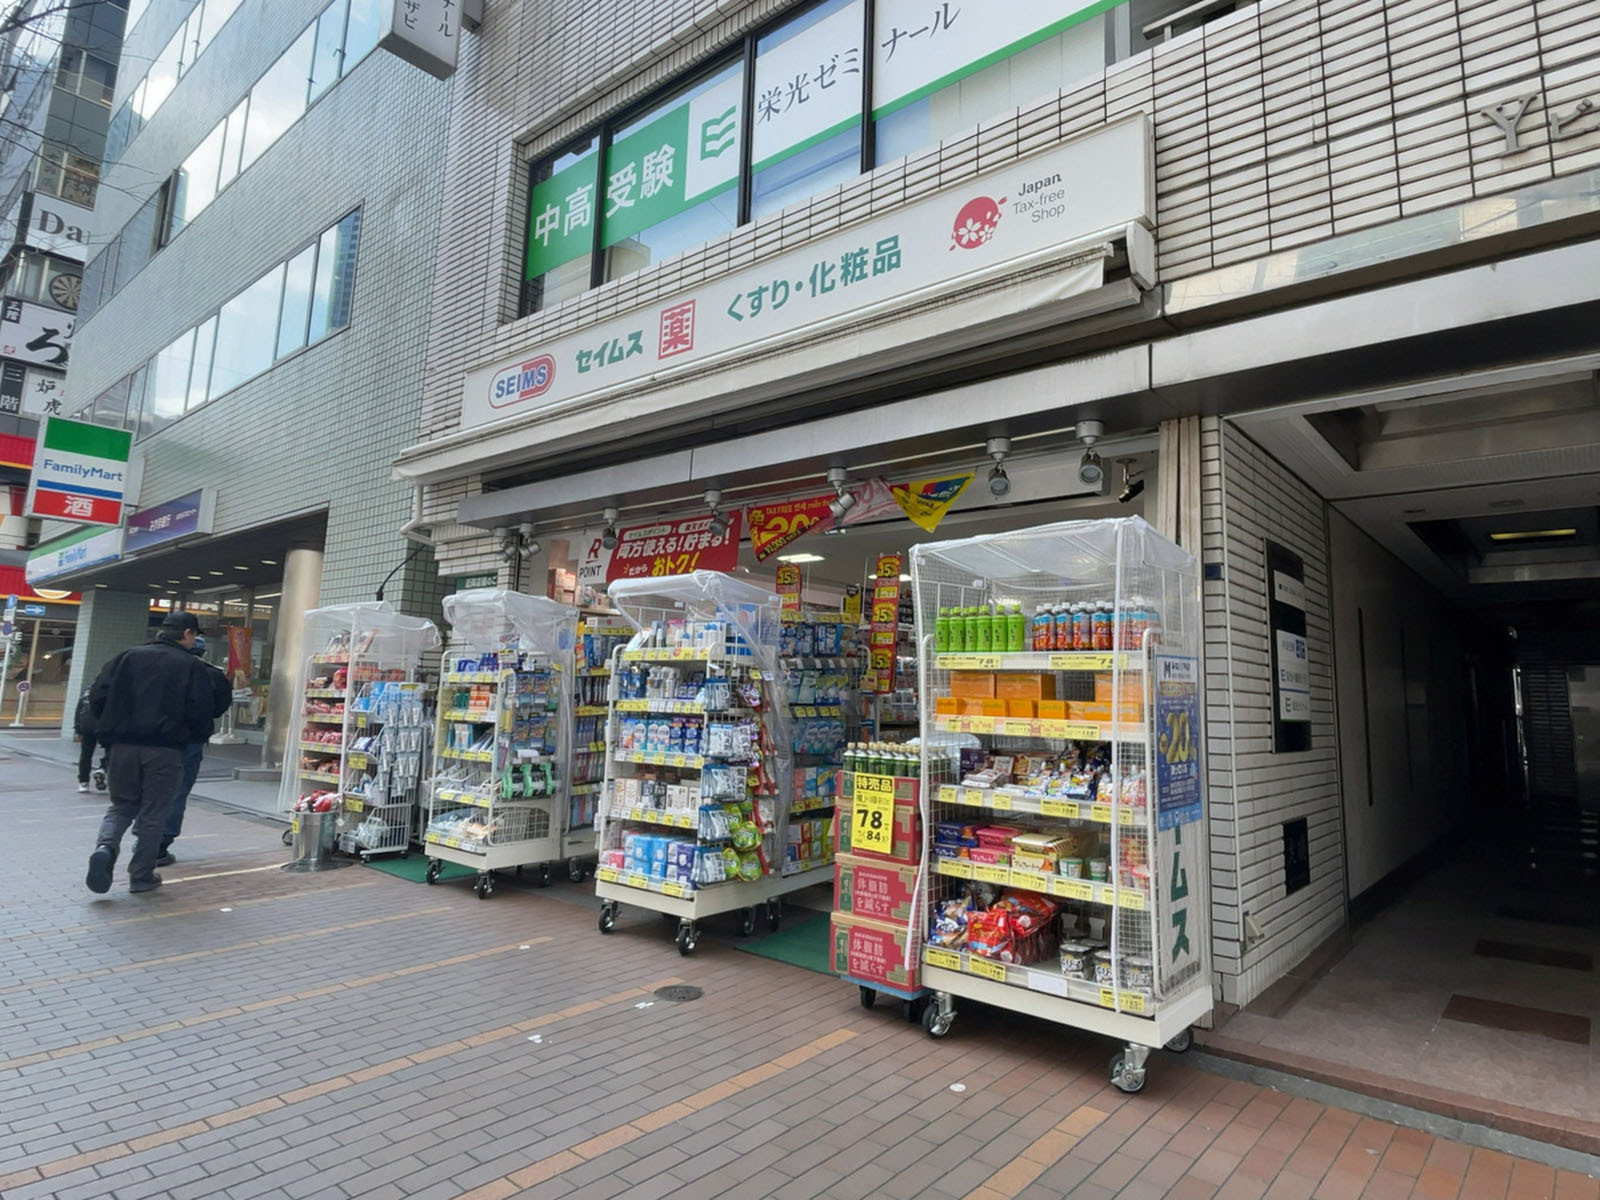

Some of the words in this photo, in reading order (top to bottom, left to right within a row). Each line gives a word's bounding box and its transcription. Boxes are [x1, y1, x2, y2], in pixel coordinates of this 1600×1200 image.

[756, 2, 961, 125] 栄光ゼミナール
[534, 143, 676, 247] 中高受験
[1018, 172, 1063, 197] Japan
[1012, 188, 1066, 216] Tax-free
[1030, 203, 1066, 225] Shop
[726, 234, 902, 323] くすり・化粧品
[661, 306, 693, 354] 薬
[576, 329, 643, 374] セイムス
[495, 364, 548, 399] SEIMS
[43, 458, 123, 482] FamilyMart
[63, 495, 94, 518] 酒
[587, 537, 602, 560] R
[580, 565, 602, 579] POINT
[857, 776, 892, 793] 特売品
[856, 809, 883, 830] 78
